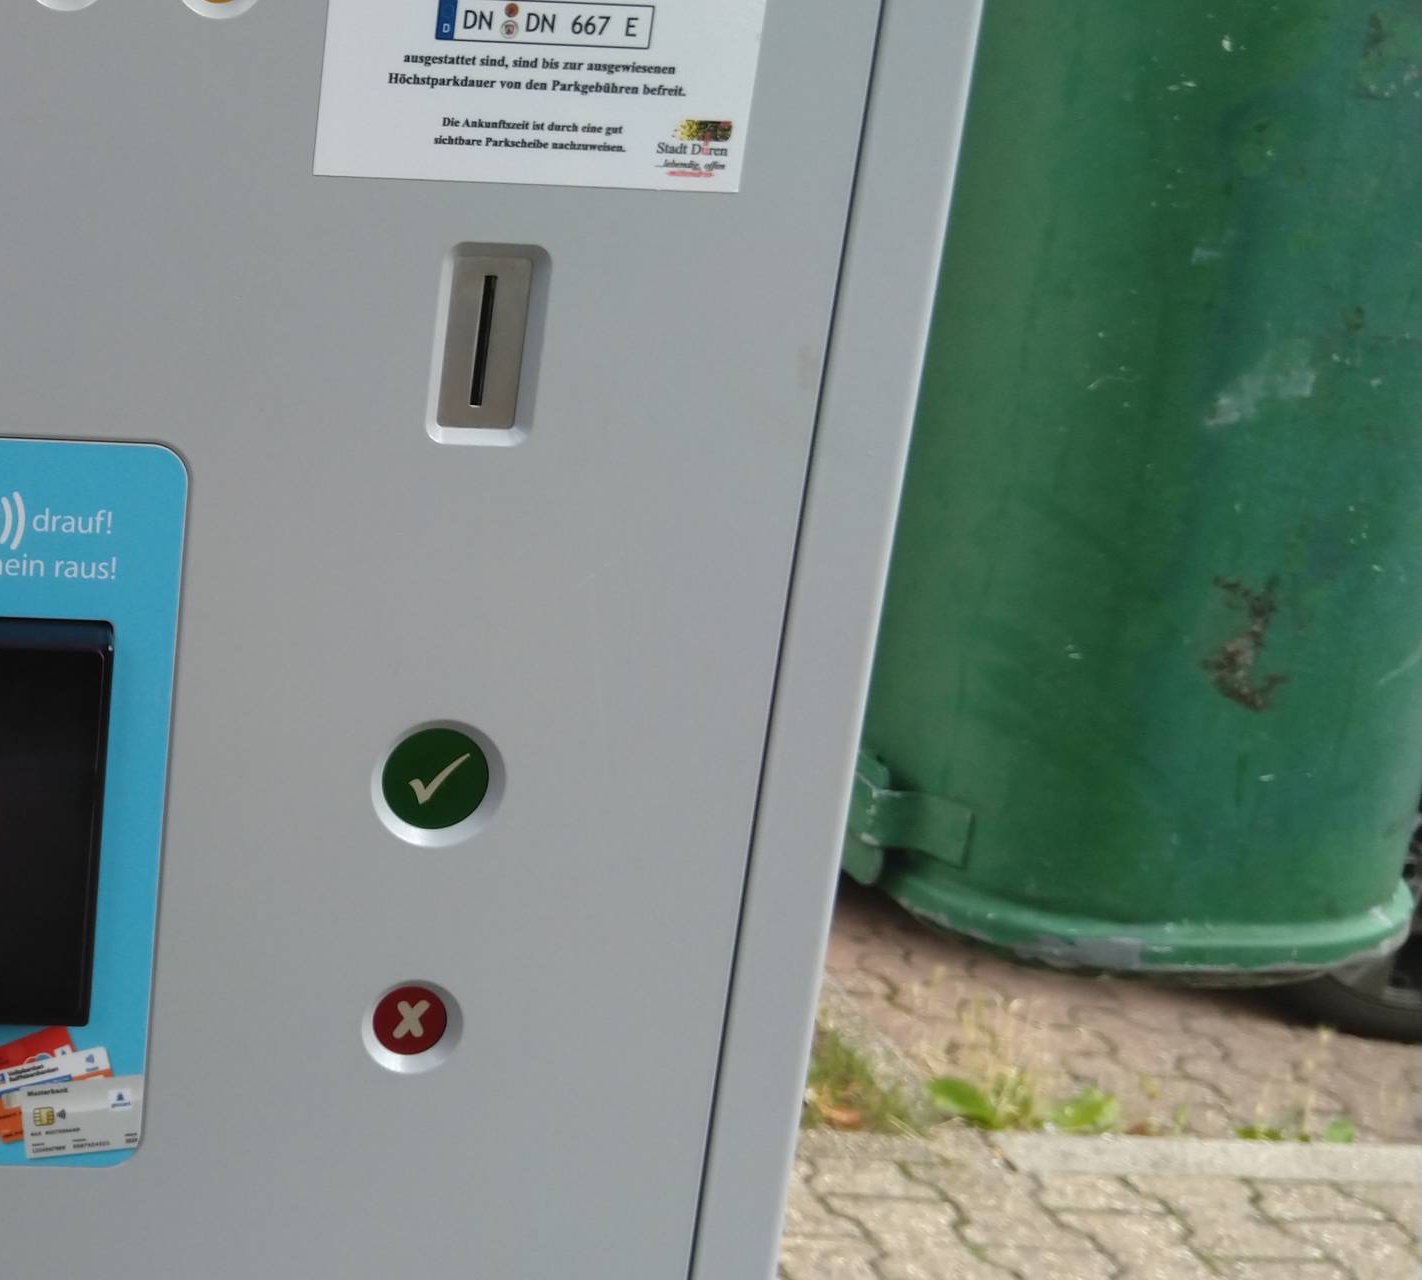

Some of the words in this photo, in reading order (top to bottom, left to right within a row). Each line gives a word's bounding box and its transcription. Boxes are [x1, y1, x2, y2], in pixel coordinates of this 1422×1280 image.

[463, 10, 494, 31] DN
[526, 12, 556, 33] DN
[571, 15, 611, 36] 667
[625, 17, 639, 37] E
[404, 53, 476, 67] ausgestattet
[480, 55, 509, 68] sind,
[513, 56, 538, 69] sind
[541, 58, 559, 70] bis
[562, 61, 583, 71] zur
[587, 62, 676, 75] ausgewiesenen
[388, 72, 496, 89] Höchstparkdauer
[500, 80, 521, 89] von
[525, 79, 548, 91] den
[552, 80, 639, 95] Parkgebühren
[643, 83, 686, 97] befreit.
[442, 117, 460, 128] Die
[462, 118, 529, 130] Ankunftszeit
[532, 120, 544, 131] ist
[548, 121, 578, 133] durch
[581, 123, 602, 133] eine
[605, 125, 623, 135] gut
[434, 135, 482, 147] sichtbare
[485, 136, 549, 149] Parkscheibe
[551, 139, 626, 152] nachzuweisen.
[656, 141, 687, 155] Stadt
[32, 508, 114, 536] drauf!
[53, 556, 118, 581] raus!
